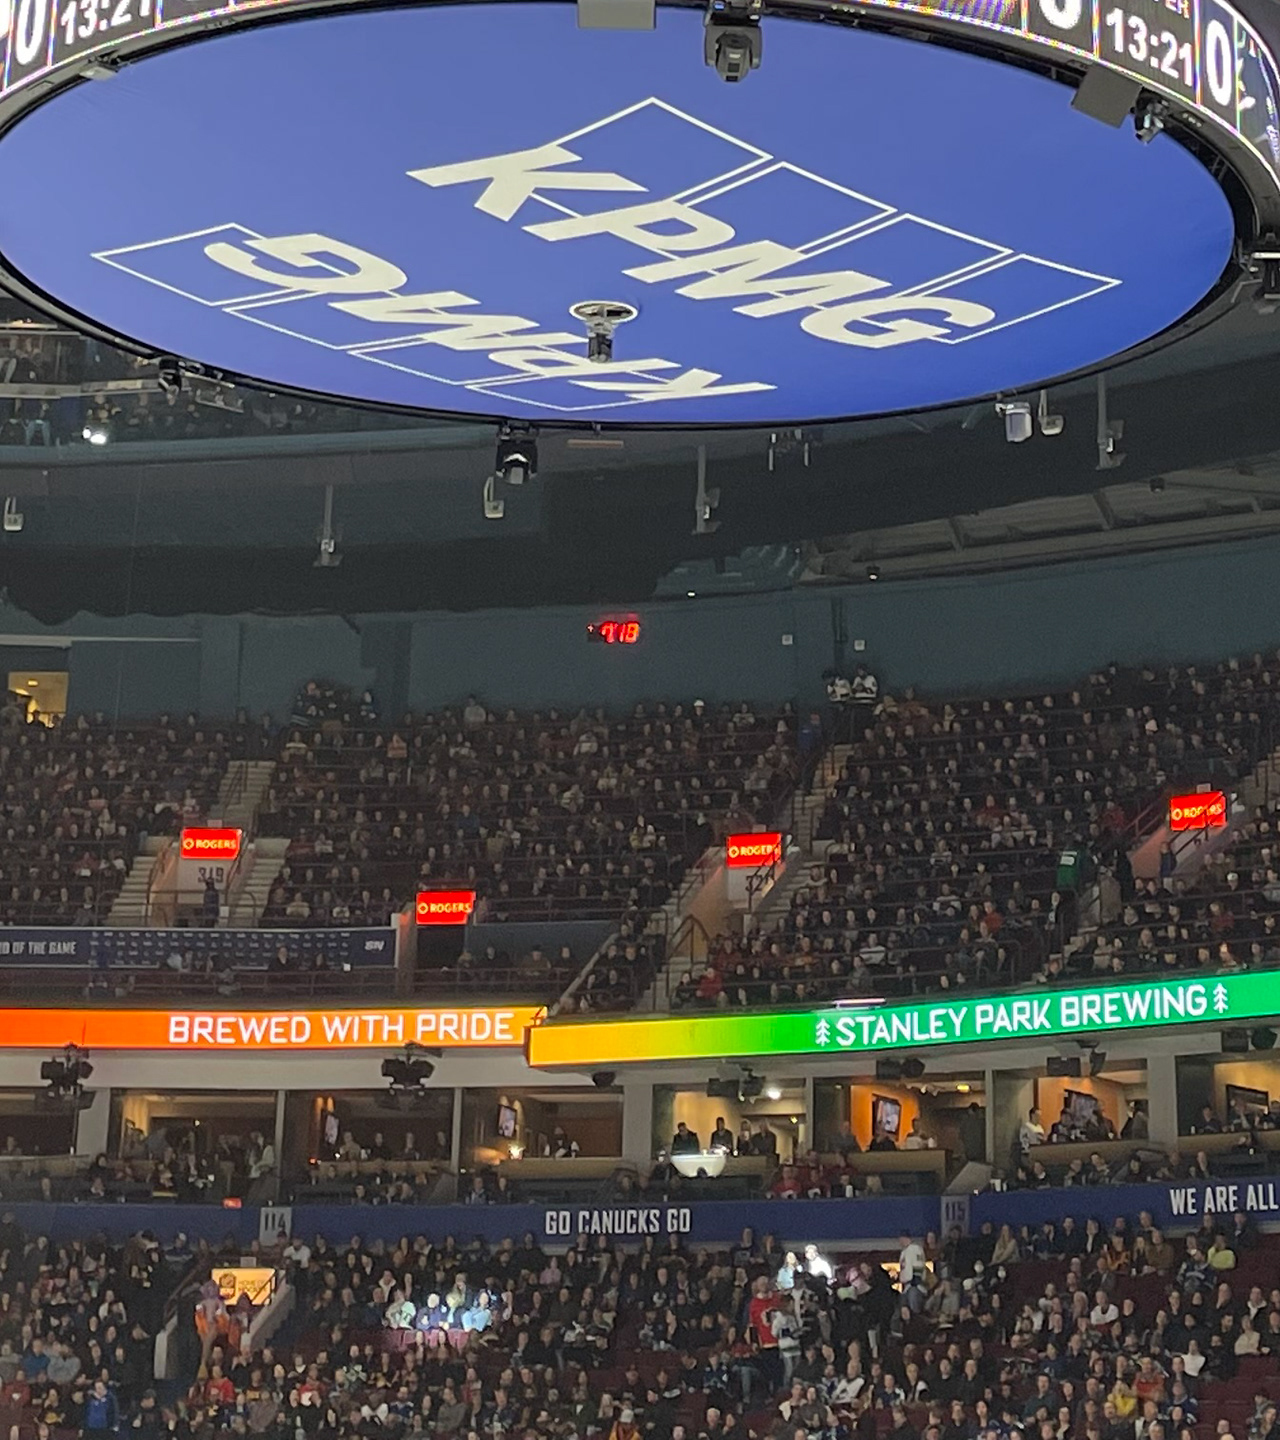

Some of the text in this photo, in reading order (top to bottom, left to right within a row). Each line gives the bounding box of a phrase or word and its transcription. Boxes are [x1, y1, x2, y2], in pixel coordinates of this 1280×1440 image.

[1104, 6, 1195, 88] 13:21
[1205, 17, 1234, 107] 0
[405, 143, 997, 349] KPMG
[203, 232, 777, 404] KPMG
[1183, 804, 1222, 819] ROGRS
[195, 838, 236, 850] ROGERS
[429, 902, 471, 914] ROGERS
[12, 941, 25, 955] OF
[28, 941, 46, 955] THE
[48, 941, 76, 955] GAME
[168, 1012, 514, 1045] BREWED WITH PRIDE
[835, 984, 1208, 1048] STANLEY PARK BREWING
[946, 1201, 966, 1221] 115
[1170, 1189, 1200, 1216] WE
[1203, 1185, 1239, 1213] ARE
[1245, 1182, 1279, 1211] ALL
[264, 1212, 286, 1231] 114
[545, 1207, 692, 1235] GO CANUCKS GO
